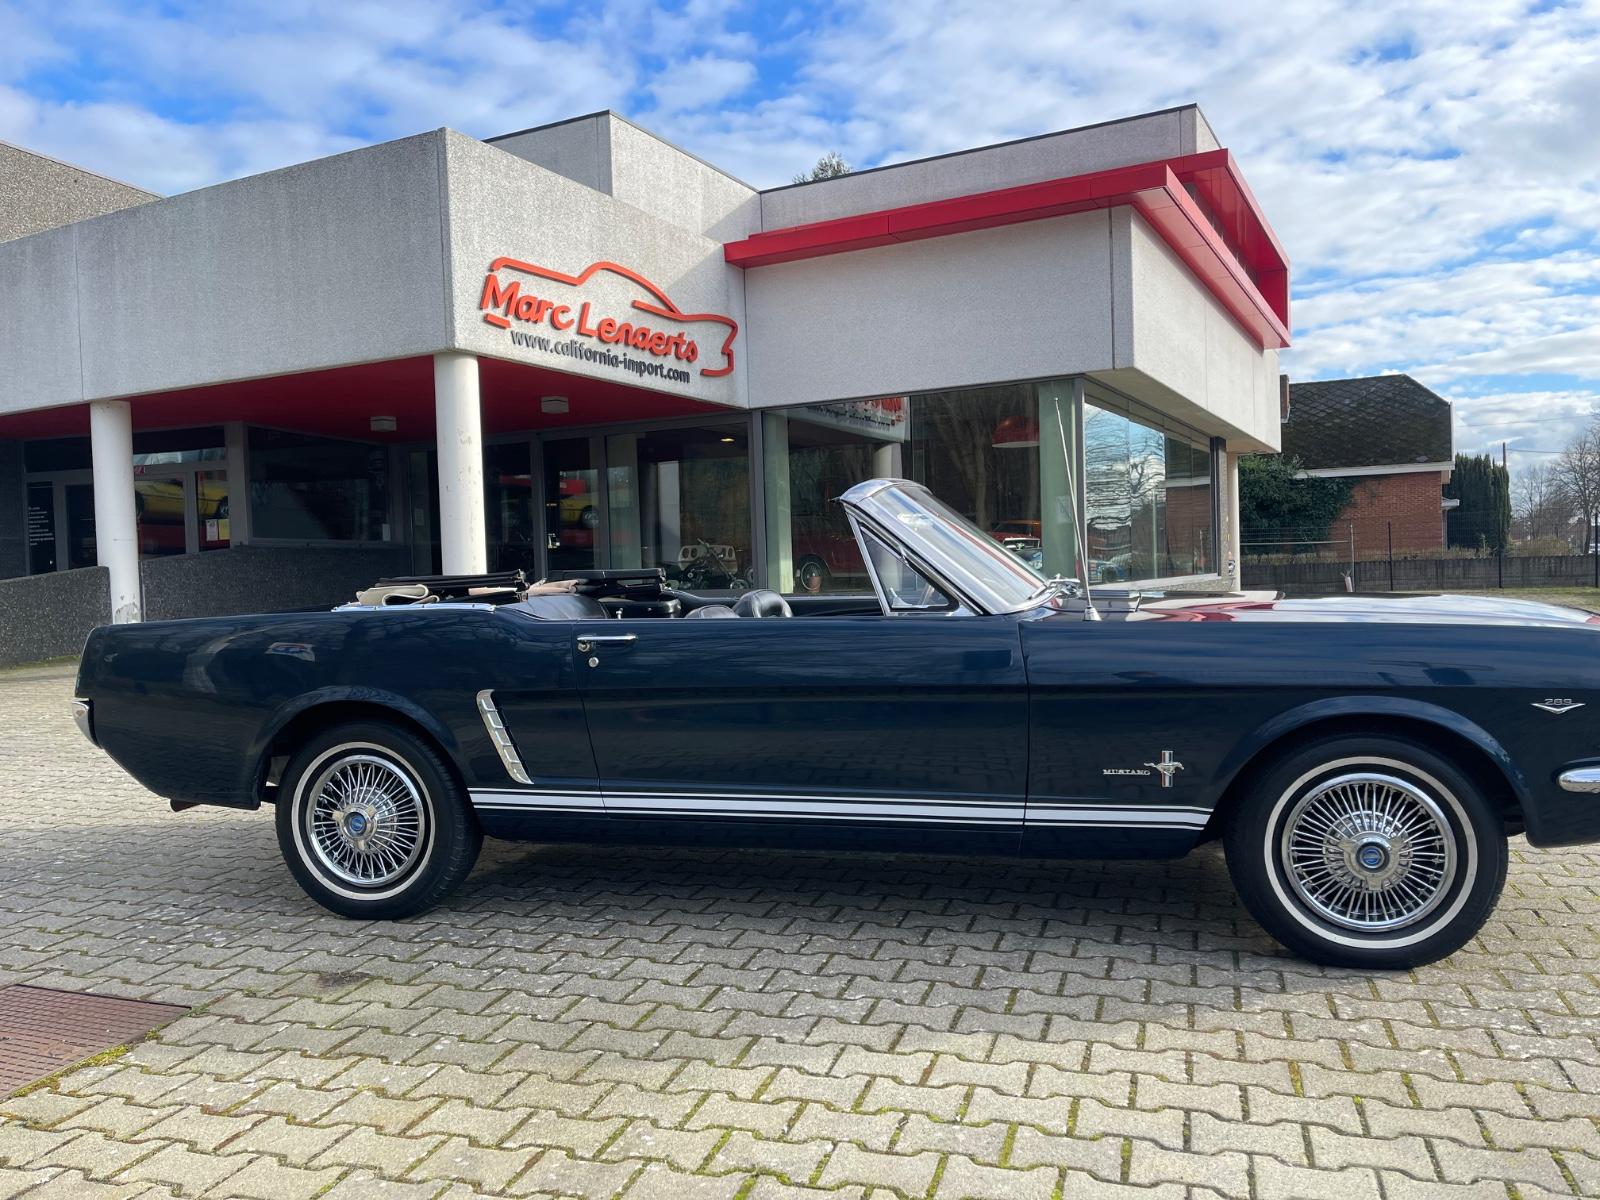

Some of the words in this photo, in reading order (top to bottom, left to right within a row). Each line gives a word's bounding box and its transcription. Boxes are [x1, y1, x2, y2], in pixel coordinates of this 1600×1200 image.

[480, 273, 575, 331] Marc
[577, 302, 699, 362] Lenaerts
[510, 330, 691, 384] www.california-import.com
[1102, 768, 1151, 776] MUSTANG
